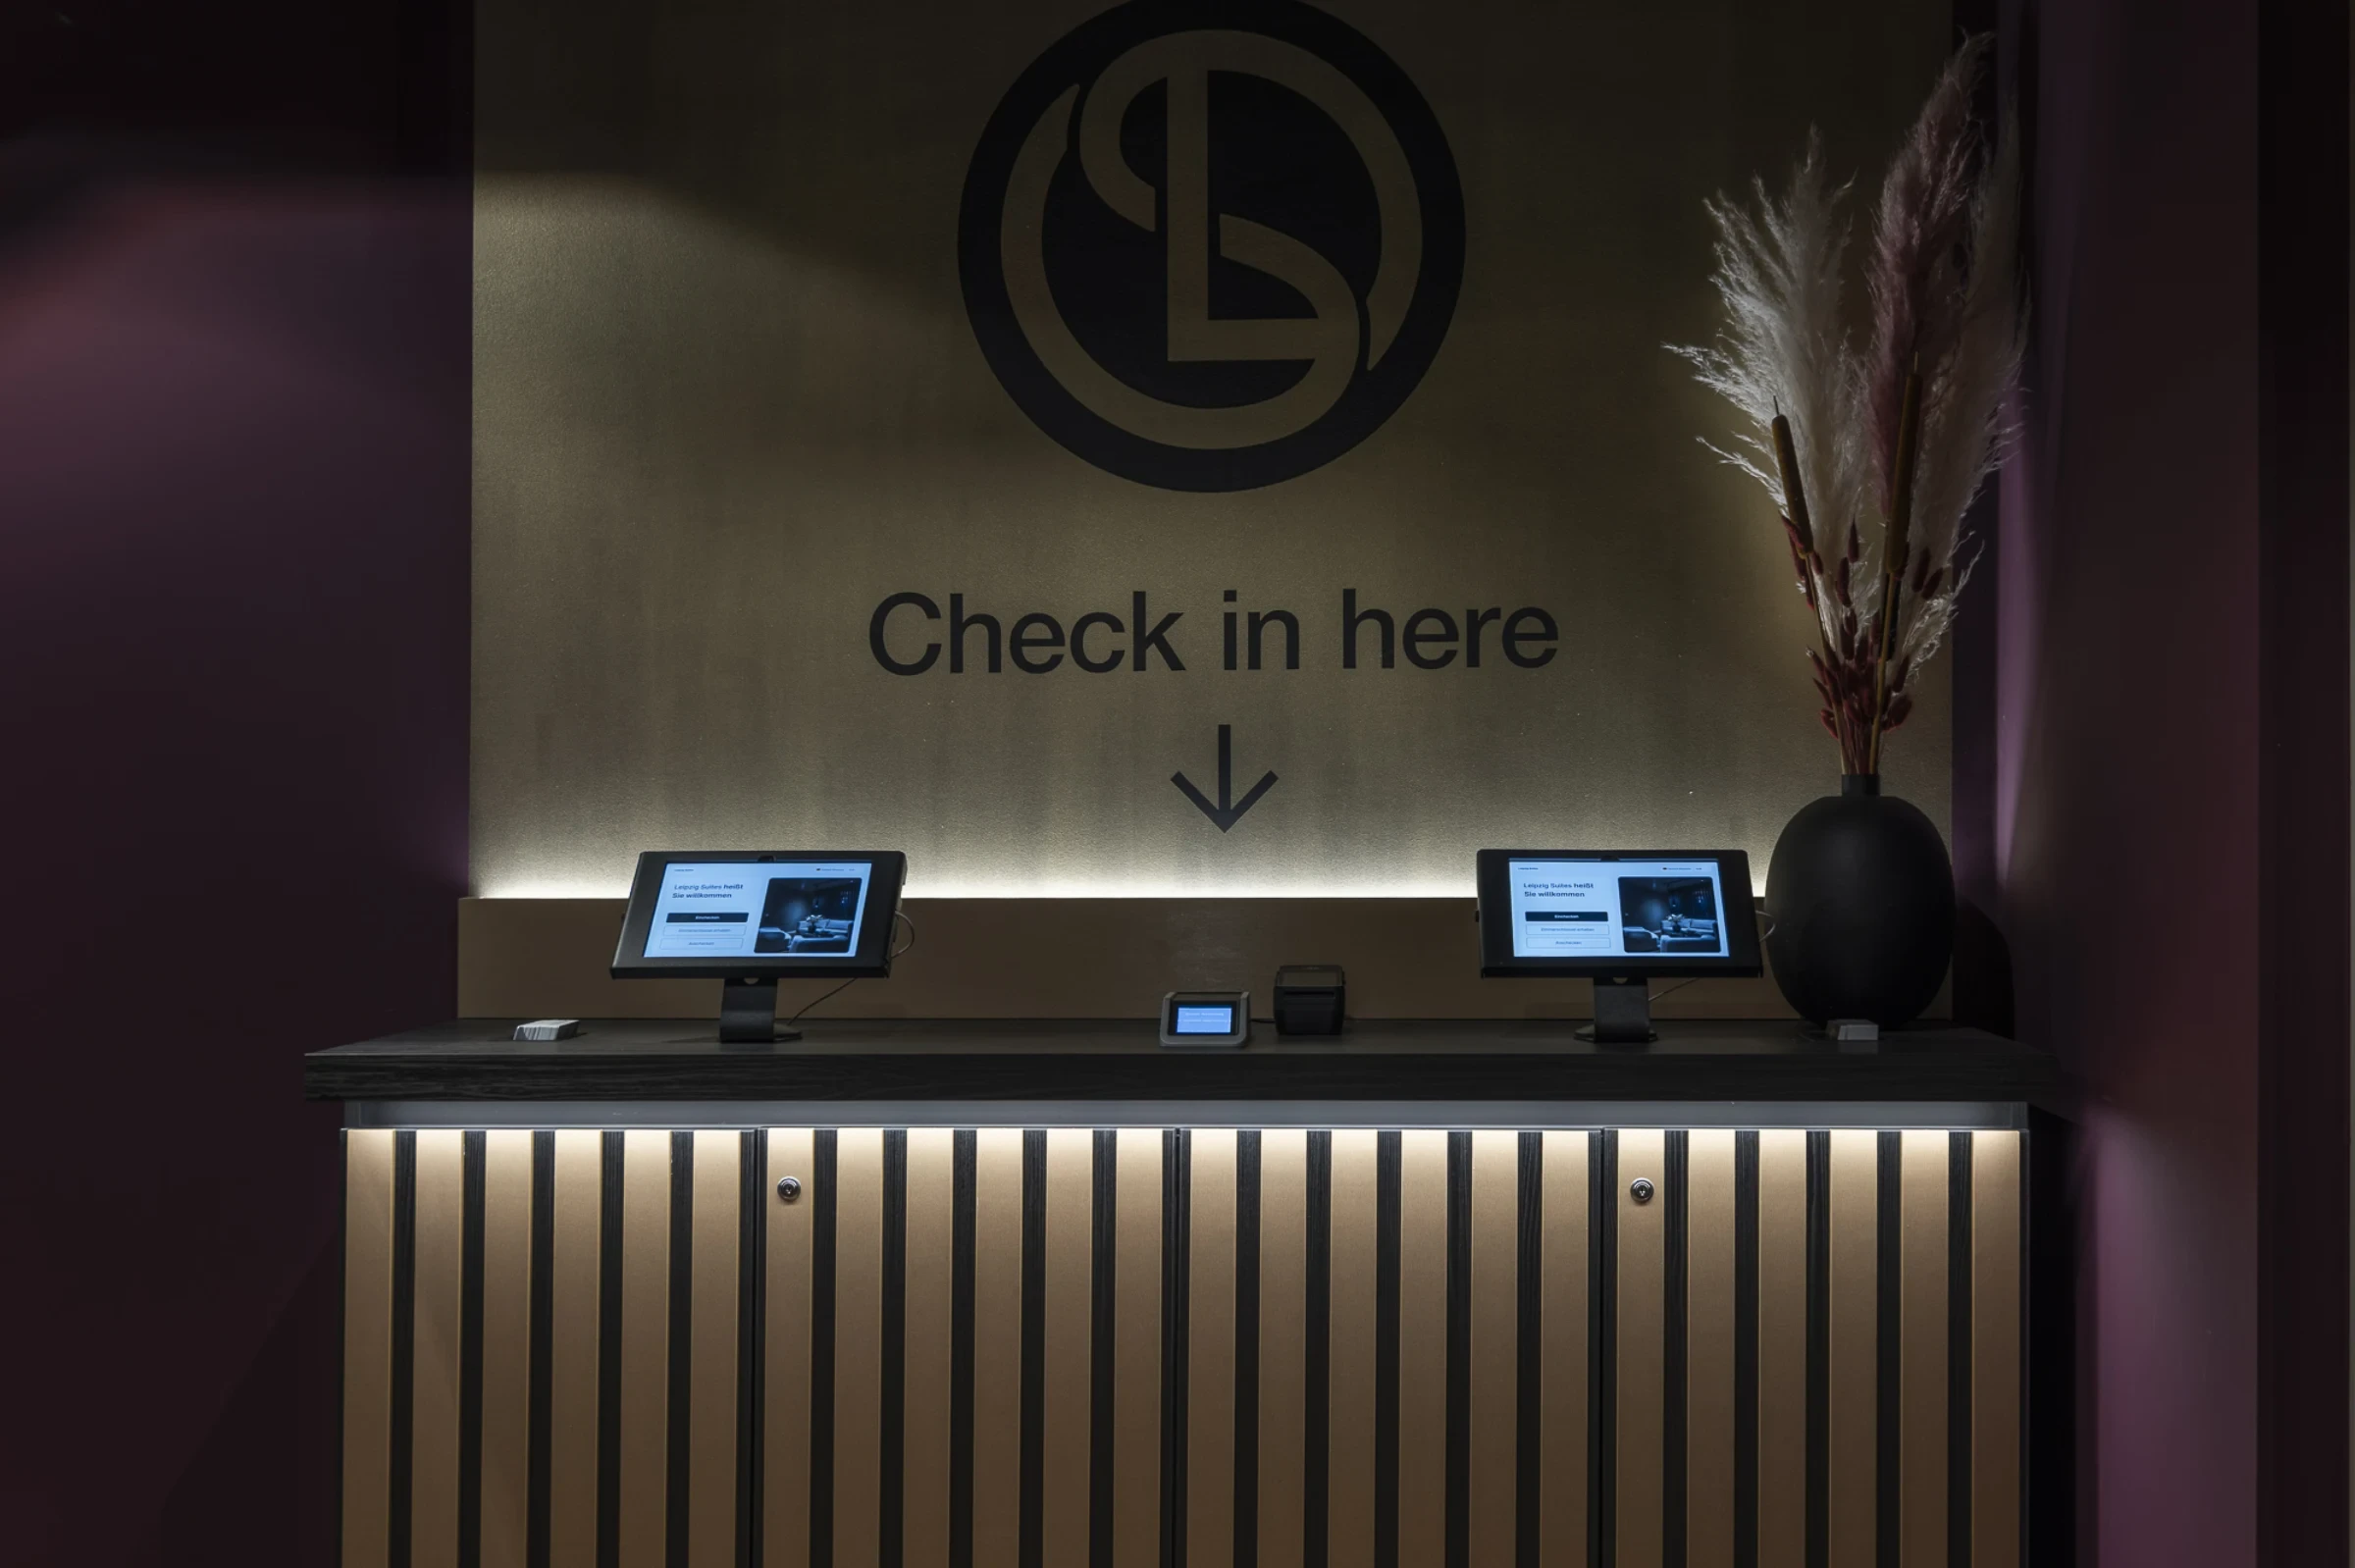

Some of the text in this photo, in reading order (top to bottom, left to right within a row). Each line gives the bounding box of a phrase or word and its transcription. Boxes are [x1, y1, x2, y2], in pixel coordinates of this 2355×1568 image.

[868, 588, 1559, 675] Check in here
